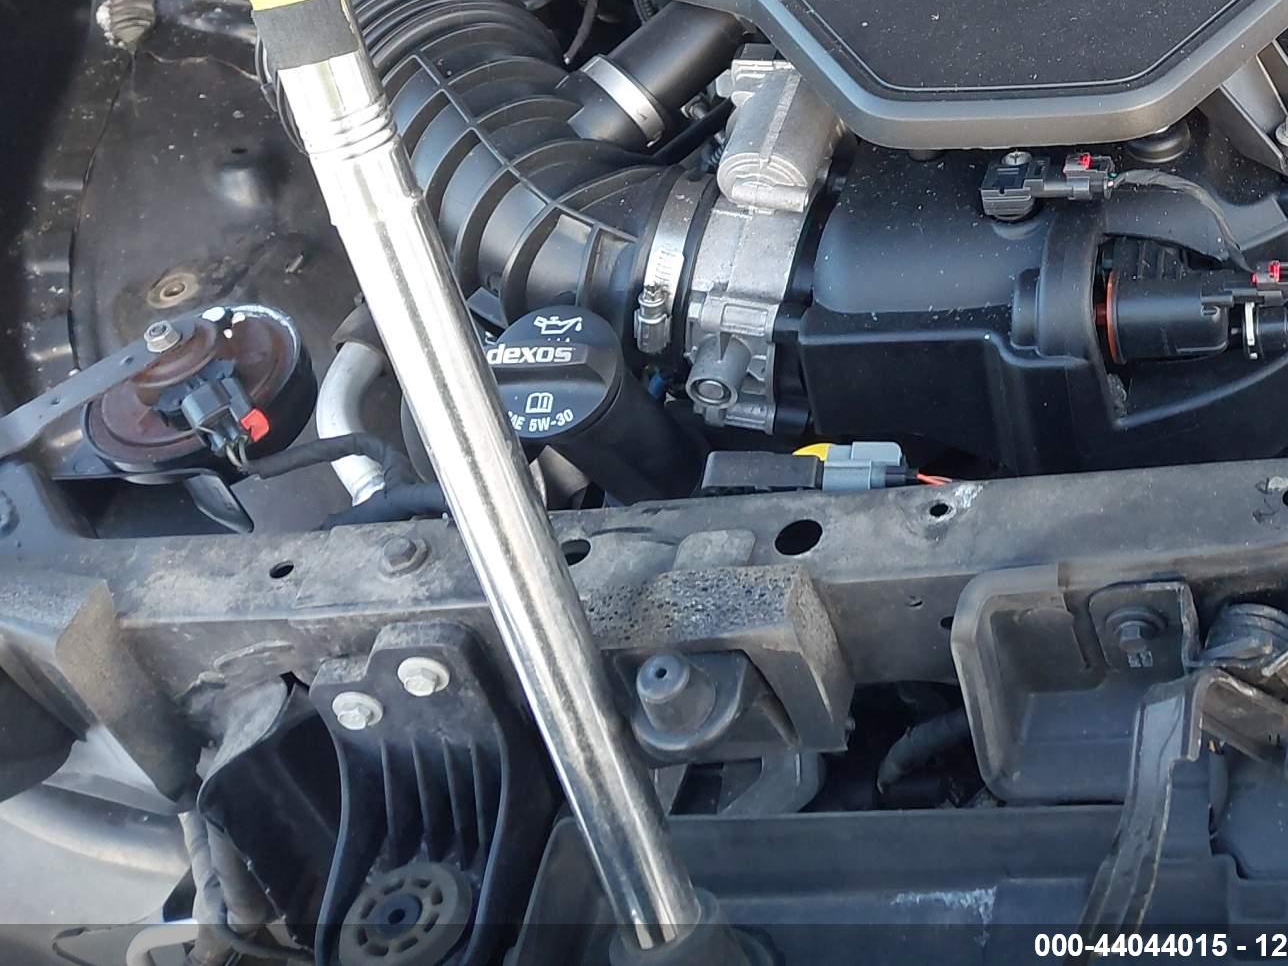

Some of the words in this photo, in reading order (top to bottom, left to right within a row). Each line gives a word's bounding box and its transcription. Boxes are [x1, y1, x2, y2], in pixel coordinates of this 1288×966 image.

[486, 344, 573, 365] dexos
[508, 411, 526, 431] AE
[528, 409, 574, 432] 5W-30
